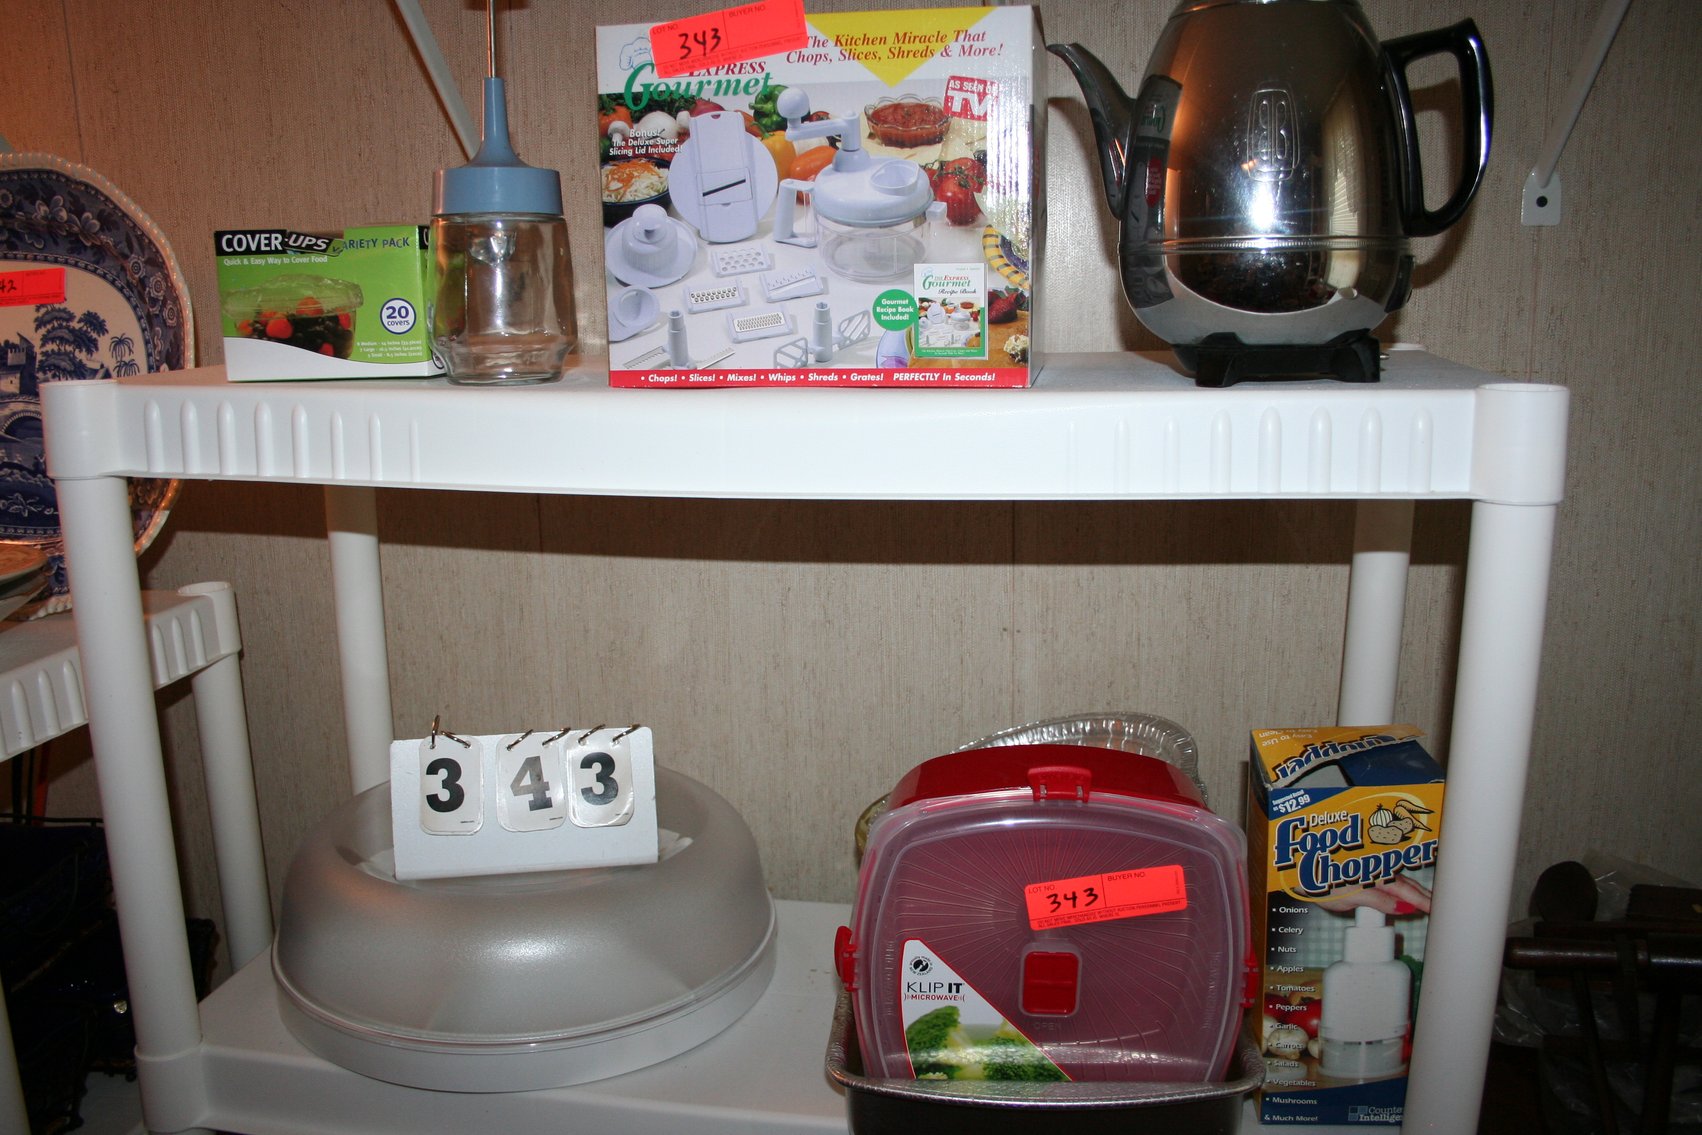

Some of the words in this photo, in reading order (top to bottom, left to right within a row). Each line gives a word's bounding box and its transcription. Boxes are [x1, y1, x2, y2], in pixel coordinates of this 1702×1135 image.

[729, 6, 754, 18] BUYER
[755, 4, 766, 13] NO
[652, 26, 666, 35] LOT
[667, 24, 679, 32] NO
[678, 27, 721, 60] 343
[834, 33, 887, 47] Kitchen
[893, 30, 948, 45] Miracle
[953, 29, 987, 42] That
[786, 50, 832, 65] Chops,
[838, 47, 882, 61] Slices,
[887, 45, 935, 60] Shreds
[940, 44, 953, 58] &
[959, 43, 1004, 57] More!
[624, 60, 773, 111] Gourmet
[949, 80, 961, 89] AS
[963, 81, 984, 92] SEEN
[947, 90, 993, 116] TV
[629, 128, 660, 138] Bonus!
[628, 138, 654, 147] Deluxe
[656, 137, 679, 147] Super
[609, 147, 633, 157] Slicing
[648, 145, 683, 154] Included!
[382, 236, 409, 248] PACK
[224, 257, 241, 266] Quick
[251, 257, 265, 266] Easy
[267, 256, 282, 265] Way
[283, 256, 290, 264] to
[292, 256, 310, 264] Cover
[312, 255, 328, 263] Food
[923, 275, 971, 290] Gourmet
[881, 298, 909, 306] Gourmet
[386, 305, 410, 319] 20
[876, 306, 897, 315] Recipe
[648, 374, 678, 384] Chops!
[688, 374, 716, 382] Slices!
[727, 373, 757, 382] Mixes!
[768, 373, 796, 383] Whips
[808, 372, 838, 381] Shreds
[850, 372, 884, 381] Grates!
[893, 372, 940, 381] PERFECTLY
[943, 372, 952, 381] In
[954, 372, 996, 381] Seconds!
[1262, 738, 1279, 746] Use
[425, 757, 465, 813] 3
[510, 755, 553, 812] 4
[580, 751, 619, 805] 3
[1279, 794, 1310, 813] $12.99
[1309, 810, 1349, 827] Deluxe
[1273, 813, 1360, 866] Food
[1298, 839, 1438, 892] Chopper
[1107, 872, 1132, 882] BUYER
[1134, 871, 1146, 879] NO
[1028, 886, 1042, 894] LOT
[1044, 884, 1055, 892] NO
[1046, 887, 1099, 913] 343
[1278, 906, 1308, 914] Onions
[1278, 926, 1304, 935] Celery
[1276, 965, 1304, 973] Apples
[907, 982, 944, 993] KLIP
[948, 983, 963, 993] IT
[1276, 984, 1315, 992] Tomatoes
[1275, 1003, 1307, 1012] Peppers
[1273, 1079, 1316, 1087] Vegetables
[1272, 1097, 1317, 1105] Mushrooms
